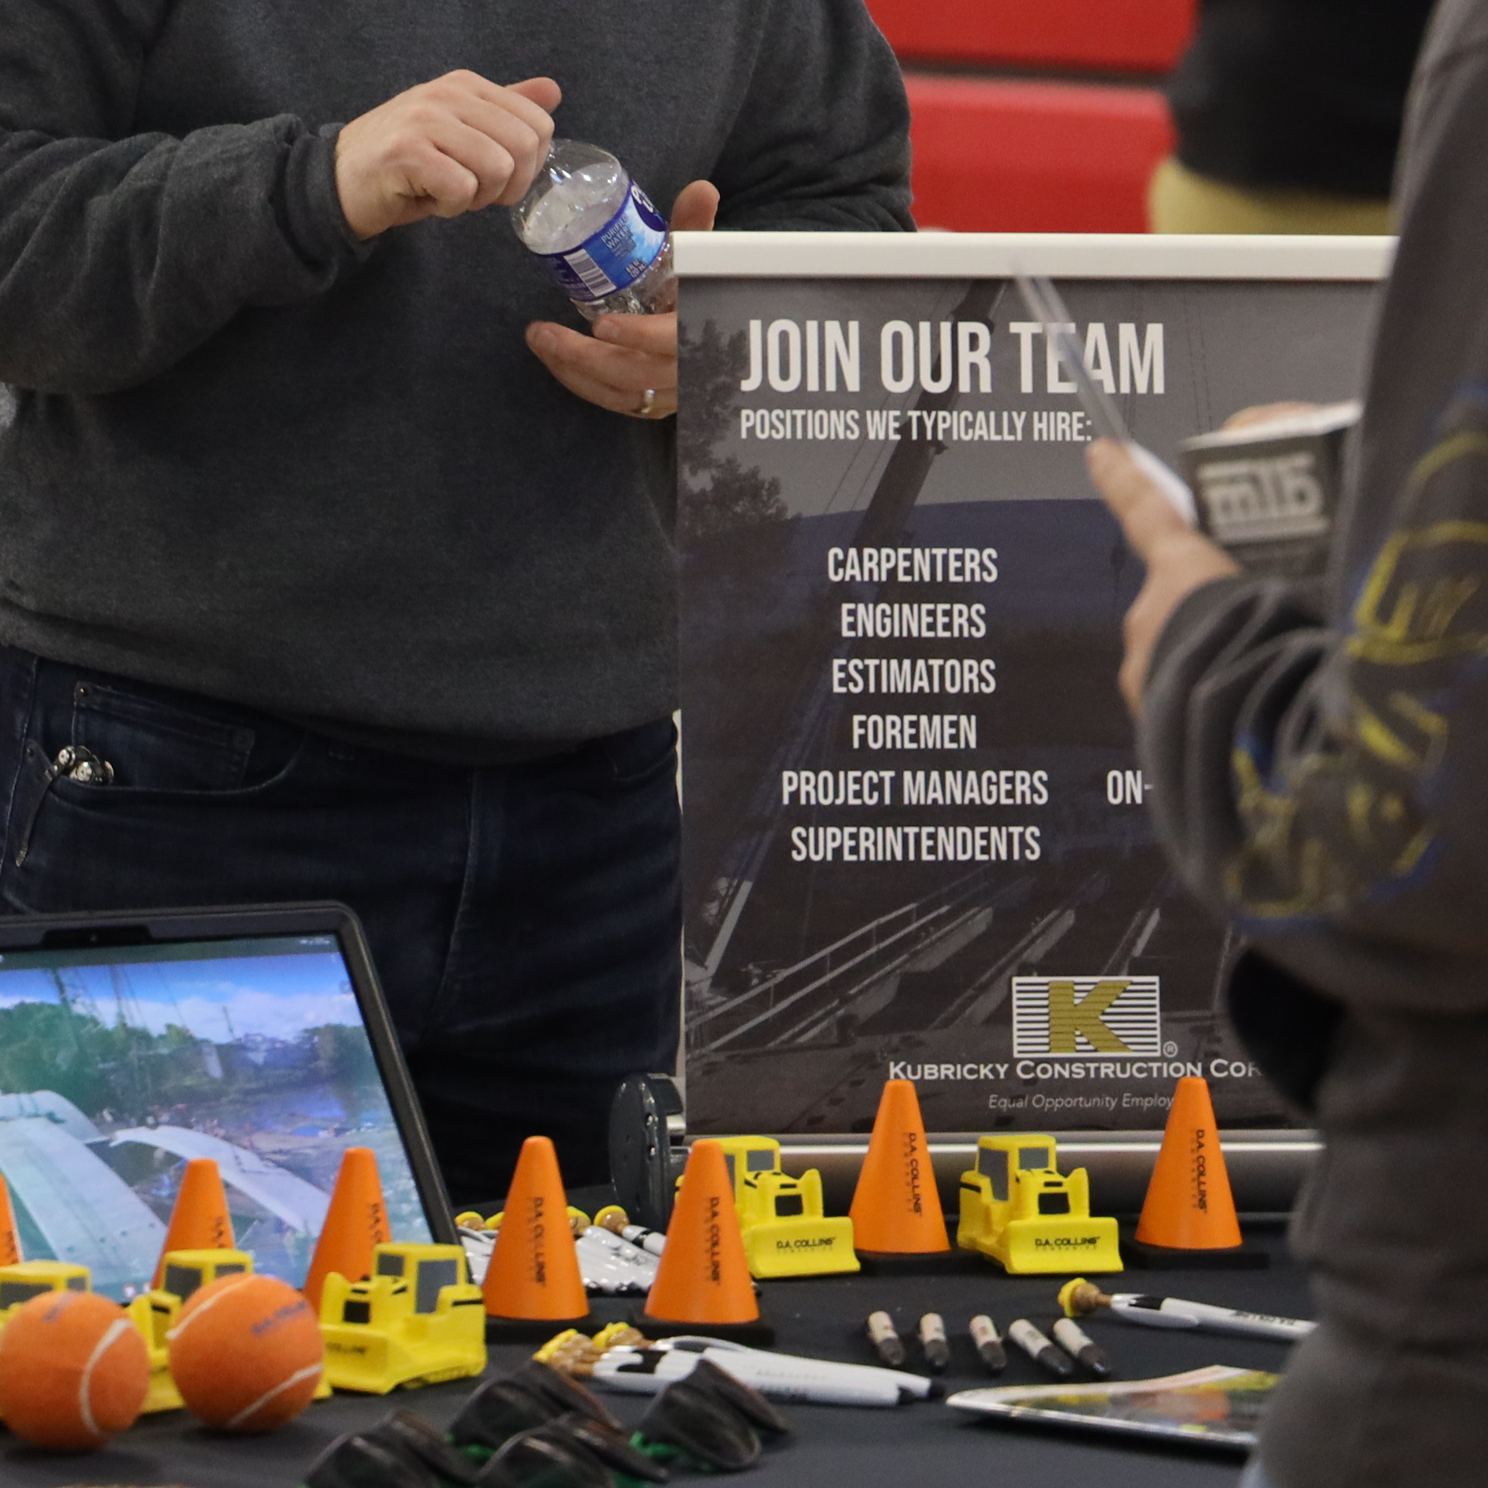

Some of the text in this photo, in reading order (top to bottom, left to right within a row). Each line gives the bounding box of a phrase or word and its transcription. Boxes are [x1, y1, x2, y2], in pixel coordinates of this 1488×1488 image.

[605, 224, 631, 249] WATER
[740, 318, 1166, 395] JOIN OUR TEAM
[740, 409, 1093, 443] POSITIONS WE TYPICALLY HIRE:
[827, 546, 999, 583] CARPENTERS
[840, 602, 987, 638] ENGINEERS
[832, 658, 997, 694] ESTIMATORS
[852, 714, 978, 750] FOREMEN
[782, 769, 1049, 806] PROJECT MANAGERS
[790, 825, 1042, 862] SUPERINTENDENTS
[988, 1094, 1029, 1112] Equal
[1031, 1093, 1118, 1112] Opportunity
